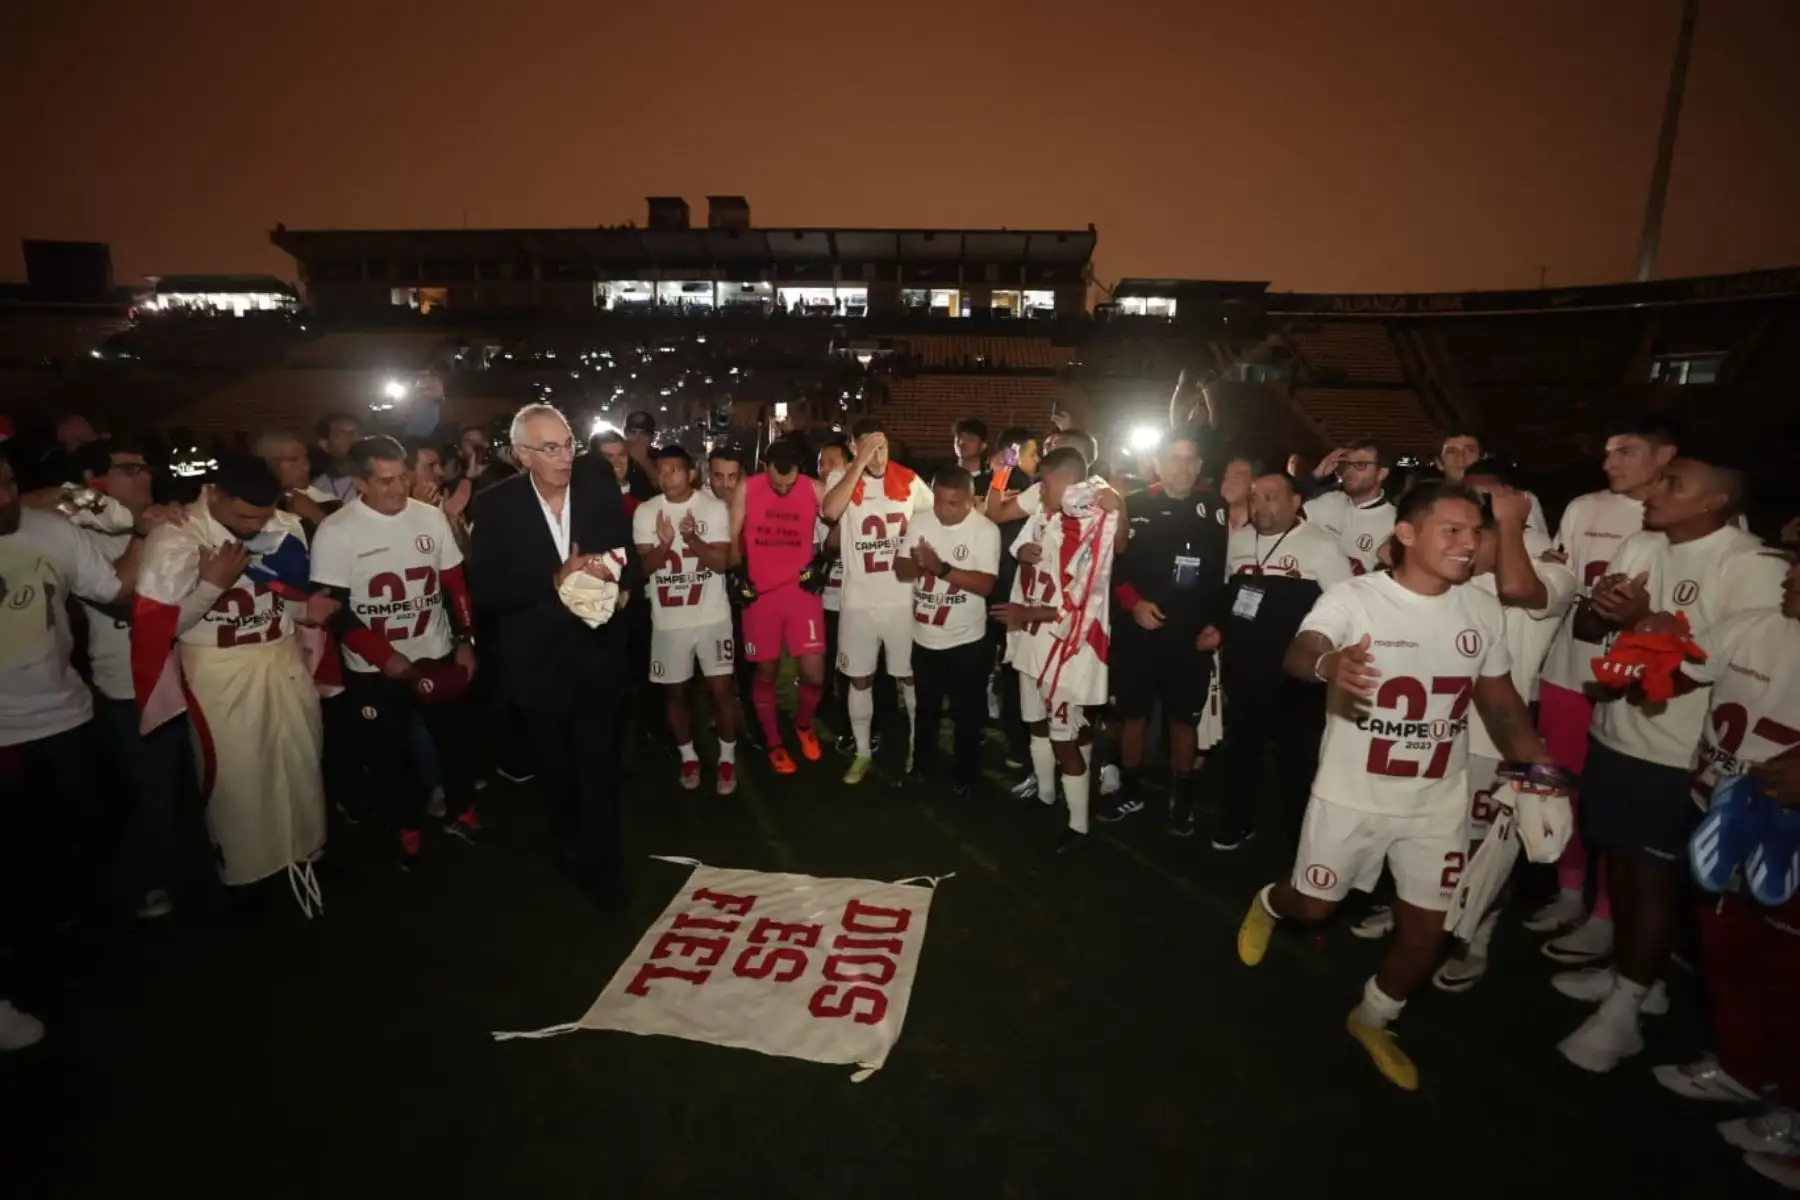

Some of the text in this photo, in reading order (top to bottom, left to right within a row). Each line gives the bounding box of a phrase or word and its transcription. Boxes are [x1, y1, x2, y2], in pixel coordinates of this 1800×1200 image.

[368, 565, 437, 642] 27
[807, 619, 817, 641] 1
[715, 639, 734, 661] 19
[1374, 638, 1420, 648] marathon
[1366, 675, 1473, 778] 27
[624, 888, 757, 996] FIEL
[732, 918, 823, 983] ES
[808, 899, 912, 1025] DIOS
